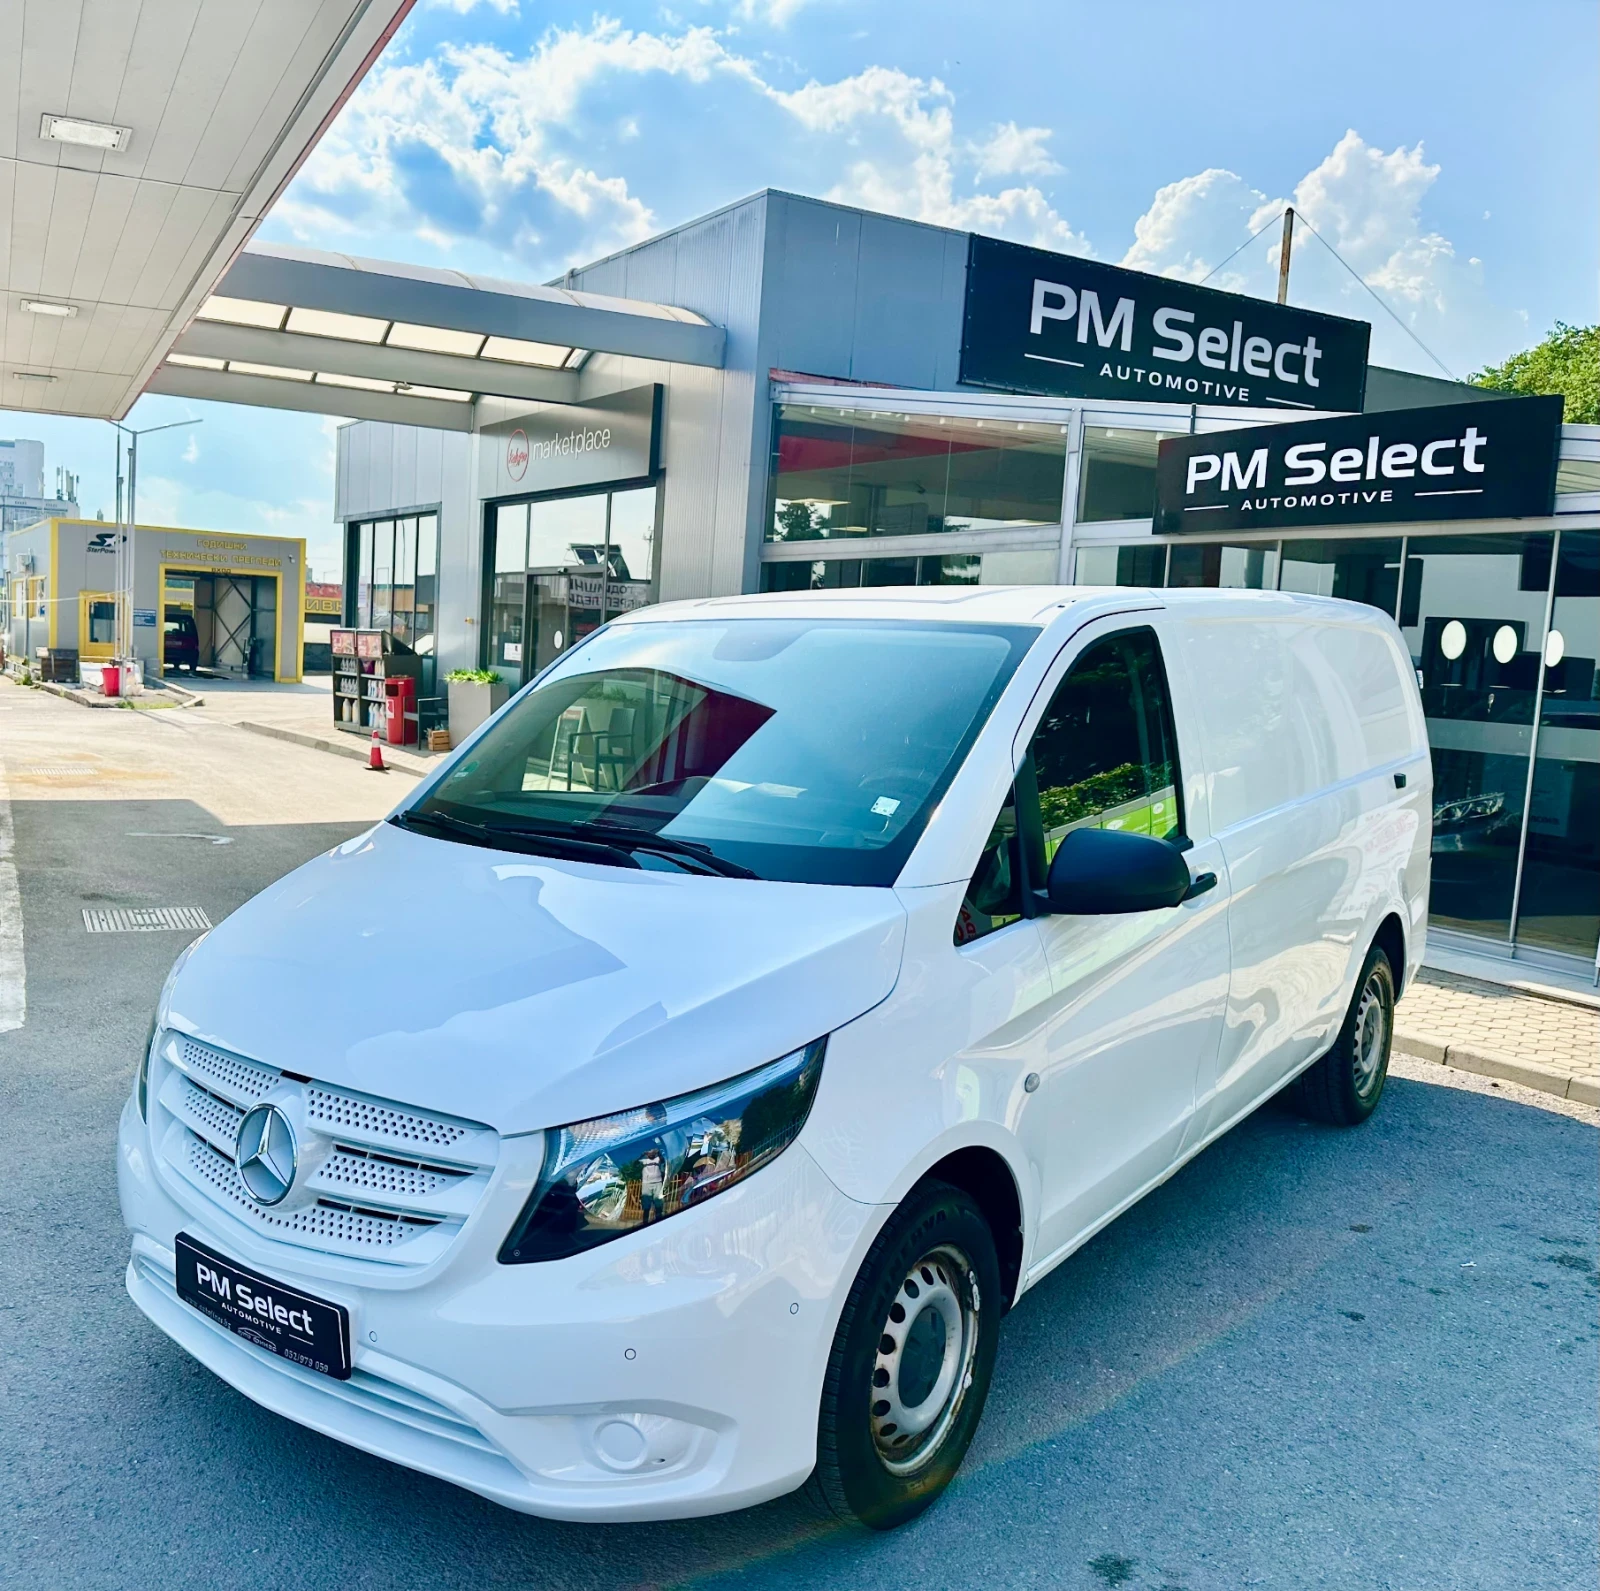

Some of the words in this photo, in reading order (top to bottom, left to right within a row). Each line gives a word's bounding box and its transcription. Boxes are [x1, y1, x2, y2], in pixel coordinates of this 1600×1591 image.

[1029, 278, 1136, 352] PM
[1152, 306, 1323, 388] Select
[1099, 362, 1250, 402] AUTOMOTIVE
[533, 427, 611, 460] marketplace
[1185, 448, 1269, 495] PM
[1284, 427, 1488, 487] Select
[1240, 489, 1394, 512] AUTOMOTIVE
[160, 549, 228, 563] ТЕХНИЧЕСКИ
[232, 555, 282, 567] ПРЕГЛЕДИ
[197, 539, 248, 550] ГОДИШНИ
[196, 1261, 232, 1301] PM
[235, 1283, 314, 1336] Select
[221, 1302, 282, 1335] AUTOMOTIVE
